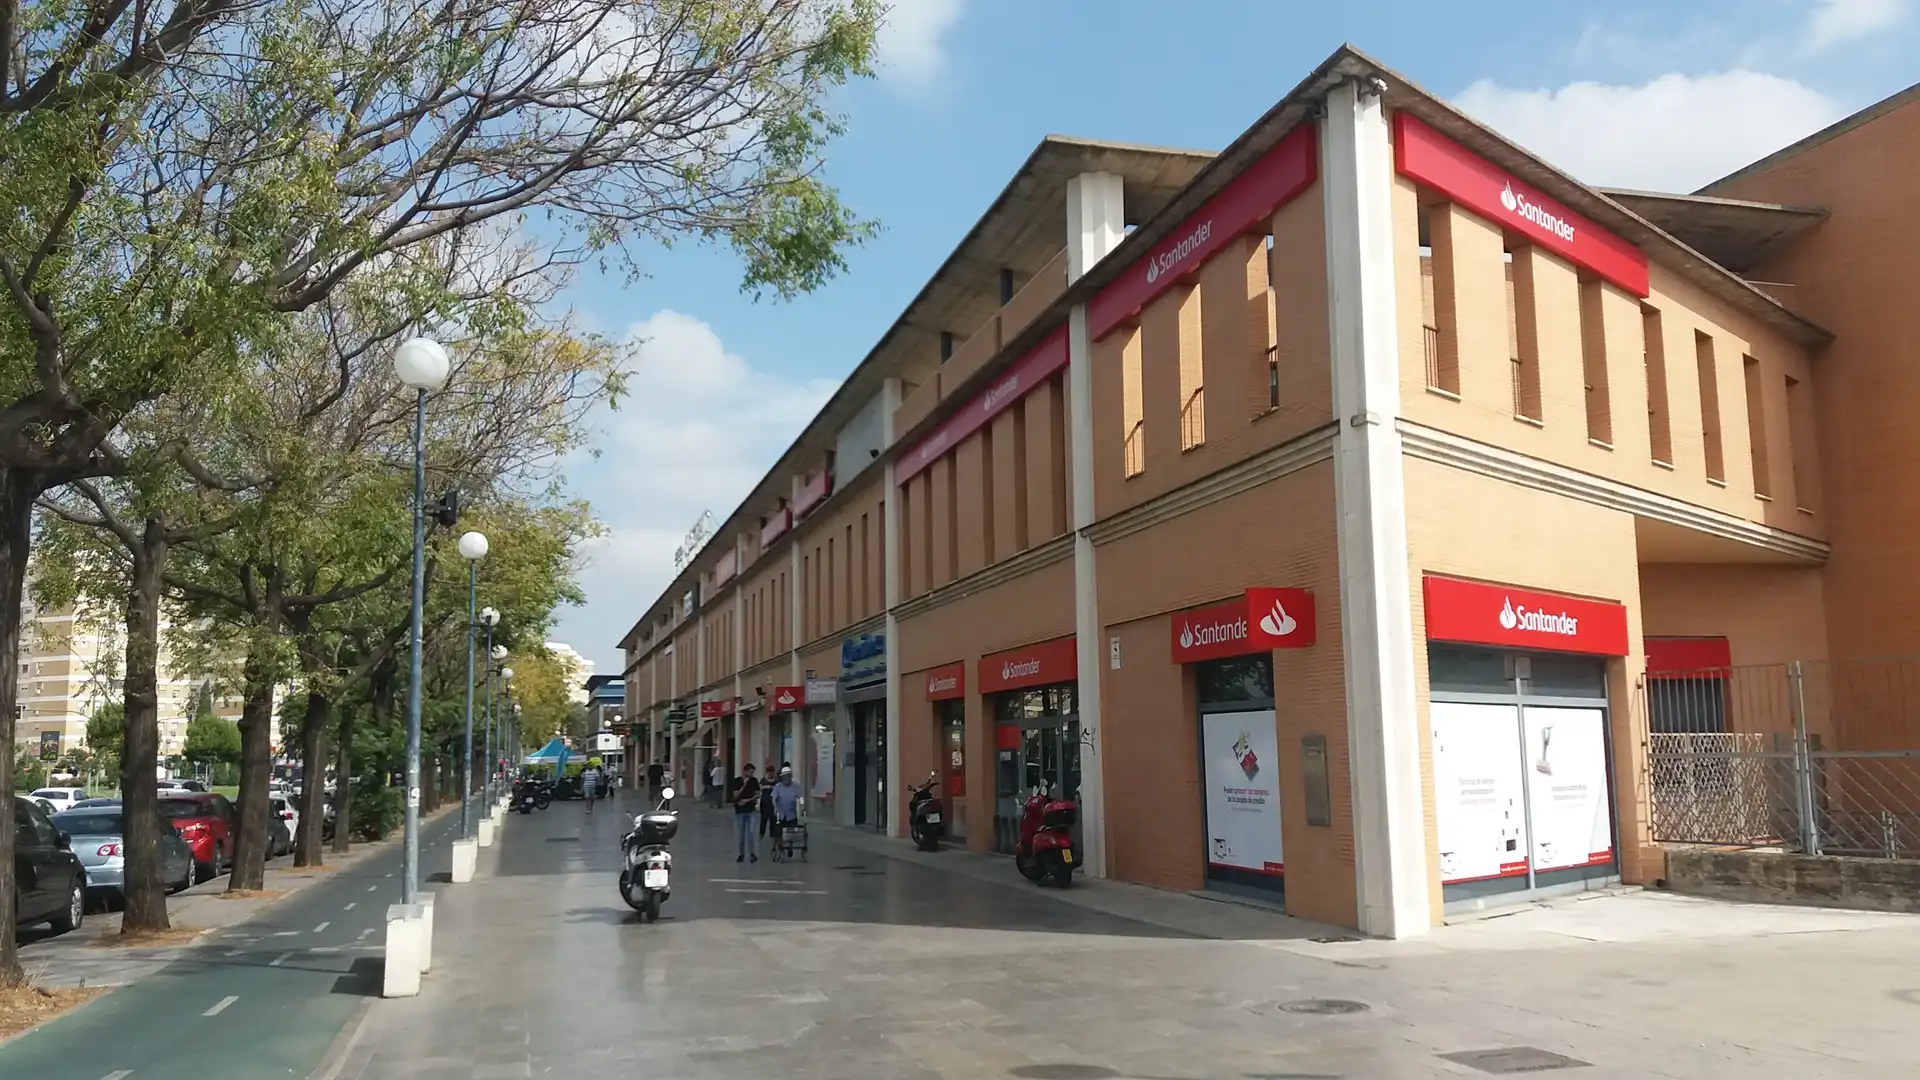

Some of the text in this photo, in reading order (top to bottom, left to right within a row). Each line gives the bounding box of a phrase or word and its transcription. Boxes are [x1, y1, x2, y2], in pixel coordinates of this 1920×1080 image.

[1517, 192, 1575, 242] Santander
[1159, 219, 1212, 275] Santander
[1195, 616, 1248, 646] Santande
[1517, 604, 1578, 635] Santander
[1010, 658, 1040, 679] Santander
